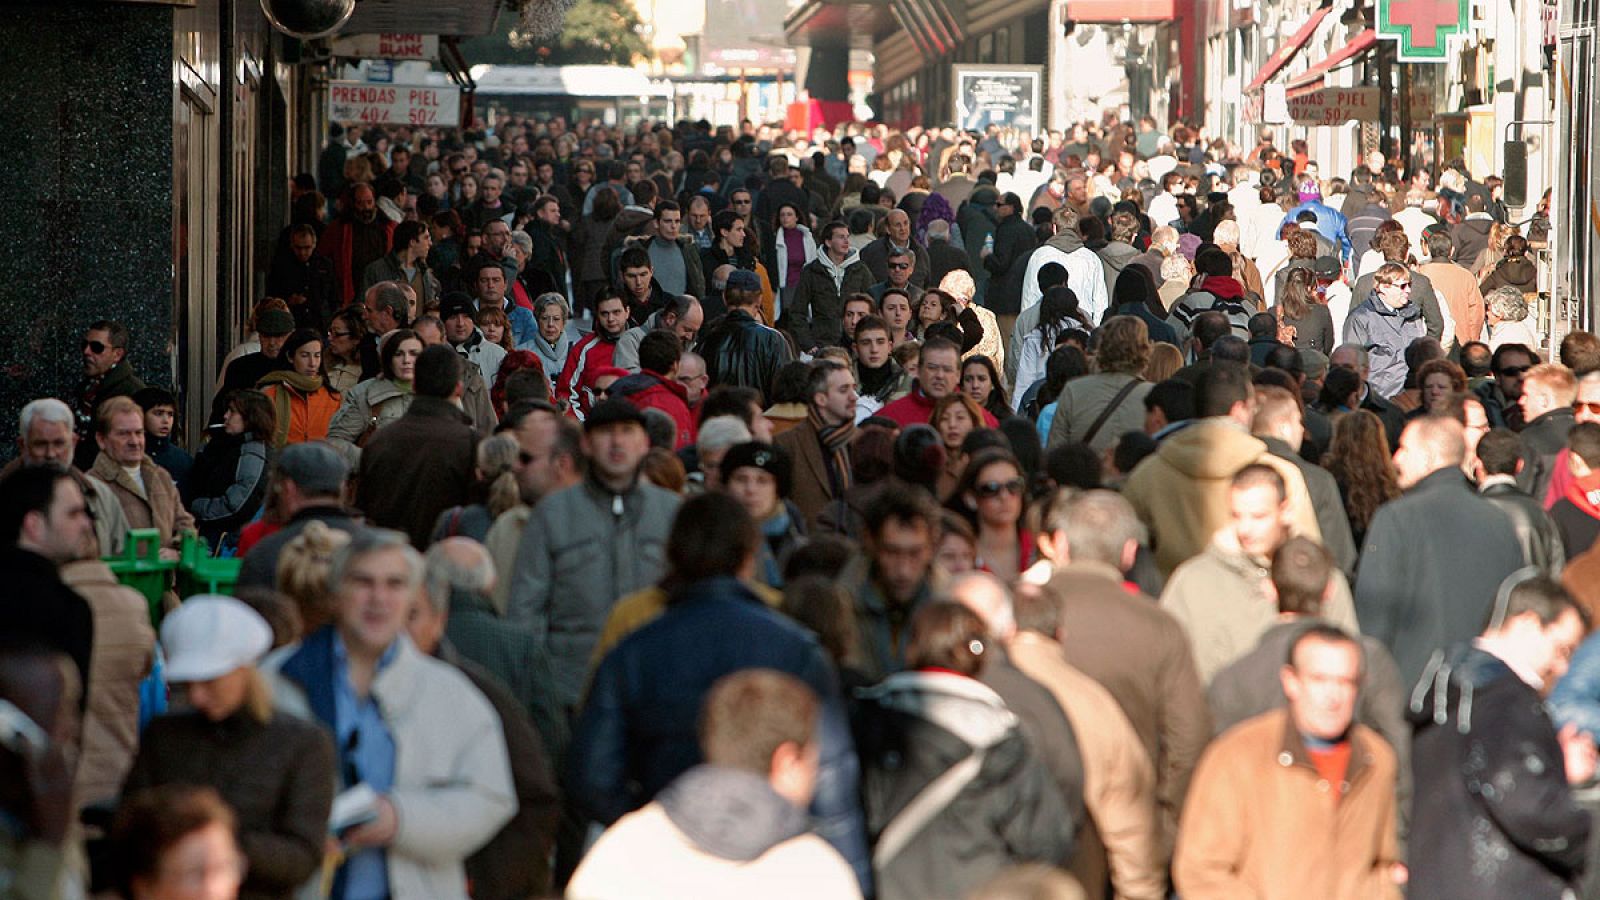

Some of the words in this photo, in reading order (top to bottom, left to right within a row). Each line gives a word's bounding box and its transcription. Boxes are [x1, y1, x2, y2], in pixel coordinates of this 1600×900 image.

[380, 43, 424, 56] BLANC
[332, 87, 396, 104] PRENDAS
[409, 90, 440, 106] PIEL
[1337, 92, 1367, 106] PIEL
[408, 108, 437, 124] 50%
